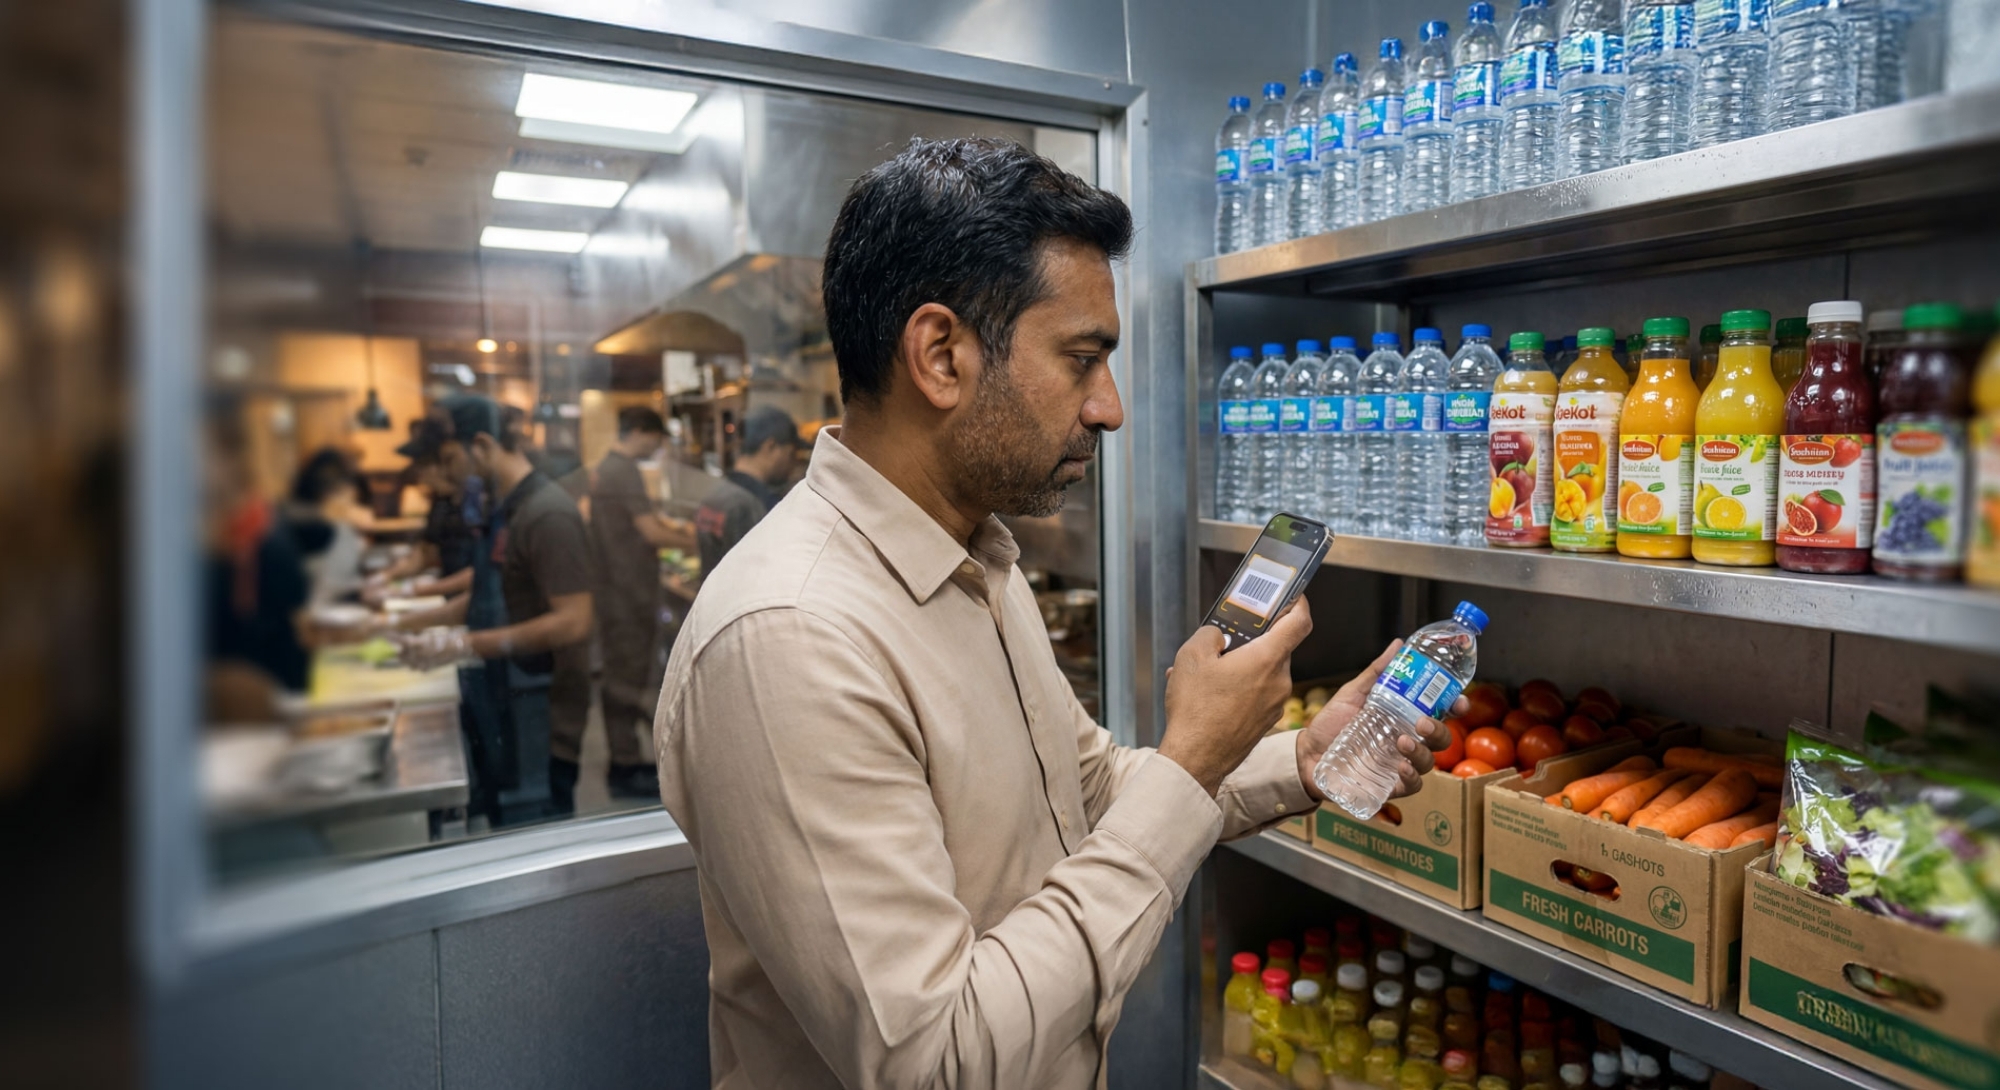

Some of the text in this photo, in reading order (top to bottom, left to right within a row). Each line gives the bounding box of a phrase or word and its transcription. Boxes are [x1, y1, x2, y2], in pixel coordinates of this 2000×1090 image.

[1333, 821, 1434, 873] FRESH TOMATOES
[1522, 890, 1649, 956] FRESH CARROTS
